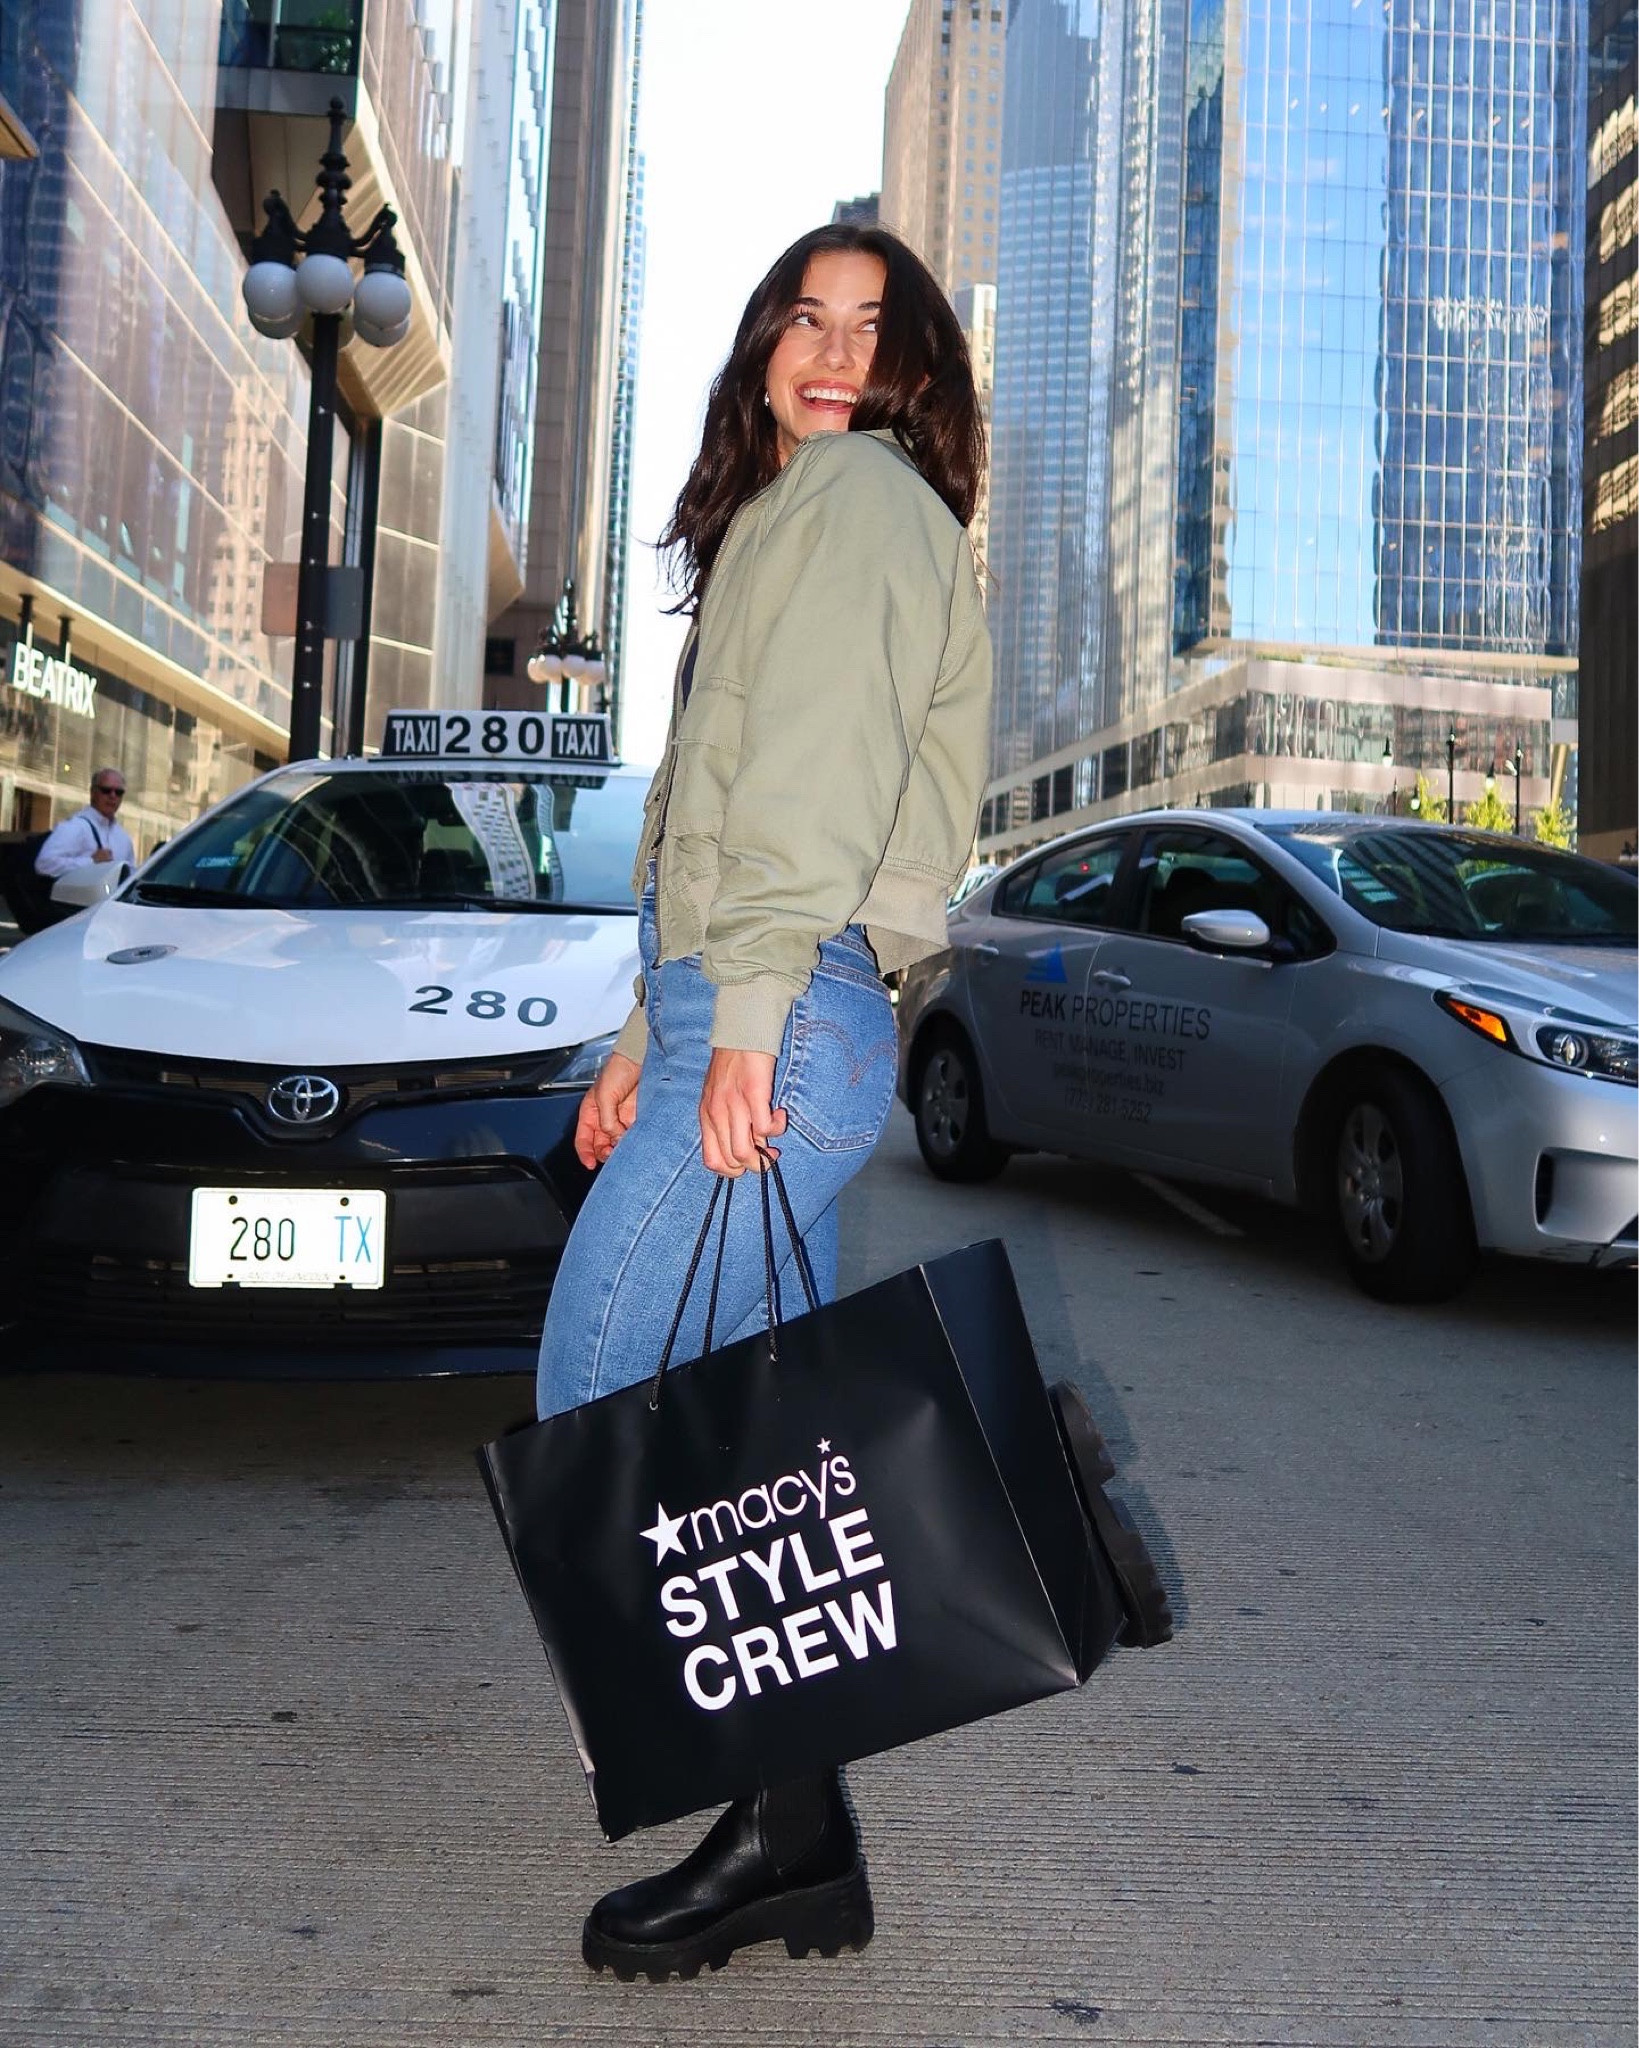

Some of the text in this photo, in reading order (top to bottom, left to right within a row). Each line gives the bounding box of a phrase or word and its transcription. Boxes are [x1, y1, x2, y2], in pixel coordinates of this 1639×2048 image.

[12, 642, 97, 719] BEATRIX
[392, 715, 600, 756] TAXI 280 TAXI
[408, 984, 558, 1027] 280
[1020, 990, 1212, 1040] PEAK PROPERTIES
[230, 1214, 372, 1263] 280 TX
[660, 1507, 885, 1638] STYLE
[683, 1580, 897, 1711] CREW
